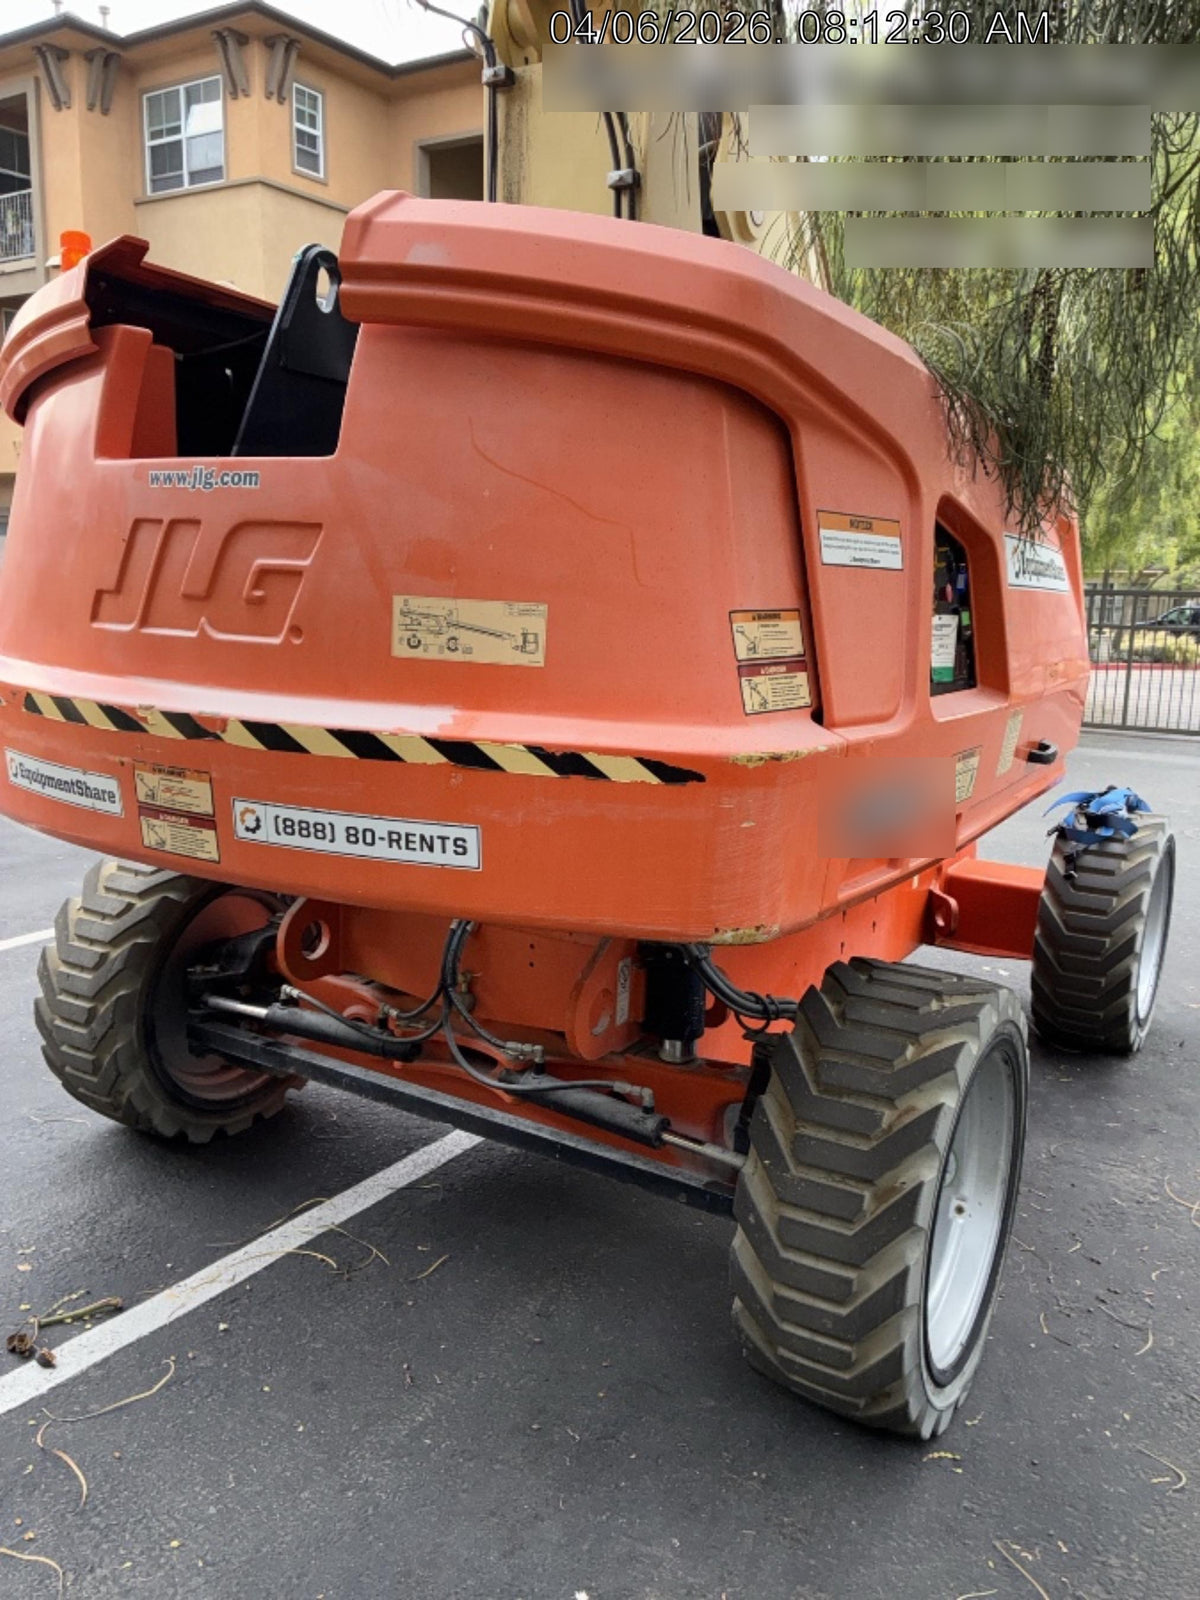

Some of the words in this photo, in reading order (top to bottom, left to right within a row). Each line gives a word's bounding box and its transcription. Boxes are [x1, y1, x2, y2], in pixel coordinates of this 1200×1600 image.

[149, 467, 261, 489] www.jlg.com
[19, 762, 116, 804] EquipmentShare
[273, 815, 336, 843] (888)
[345, 826, 468, 856] 80-RENTS
